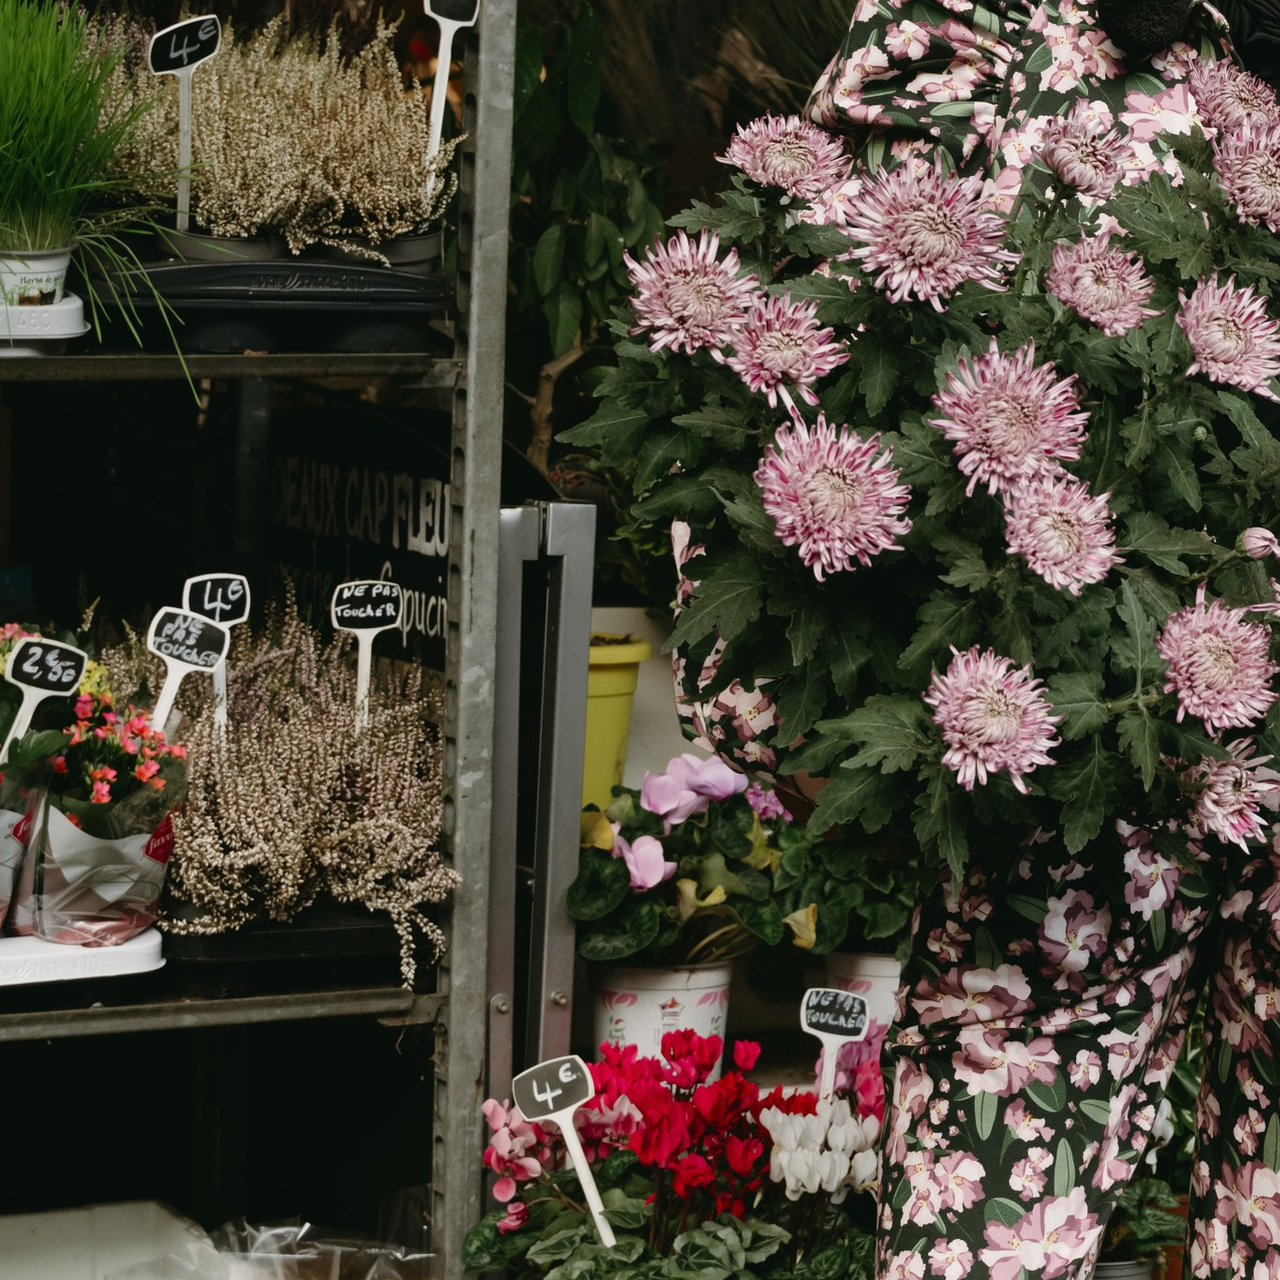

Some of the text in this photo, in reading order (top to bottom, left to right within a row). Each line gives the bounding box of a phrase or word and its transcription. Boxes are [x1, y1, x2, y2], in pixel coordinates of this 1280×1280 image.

[392, 472, 450, 557] FLEU
[342, 584, 399, 600] NE PAS
